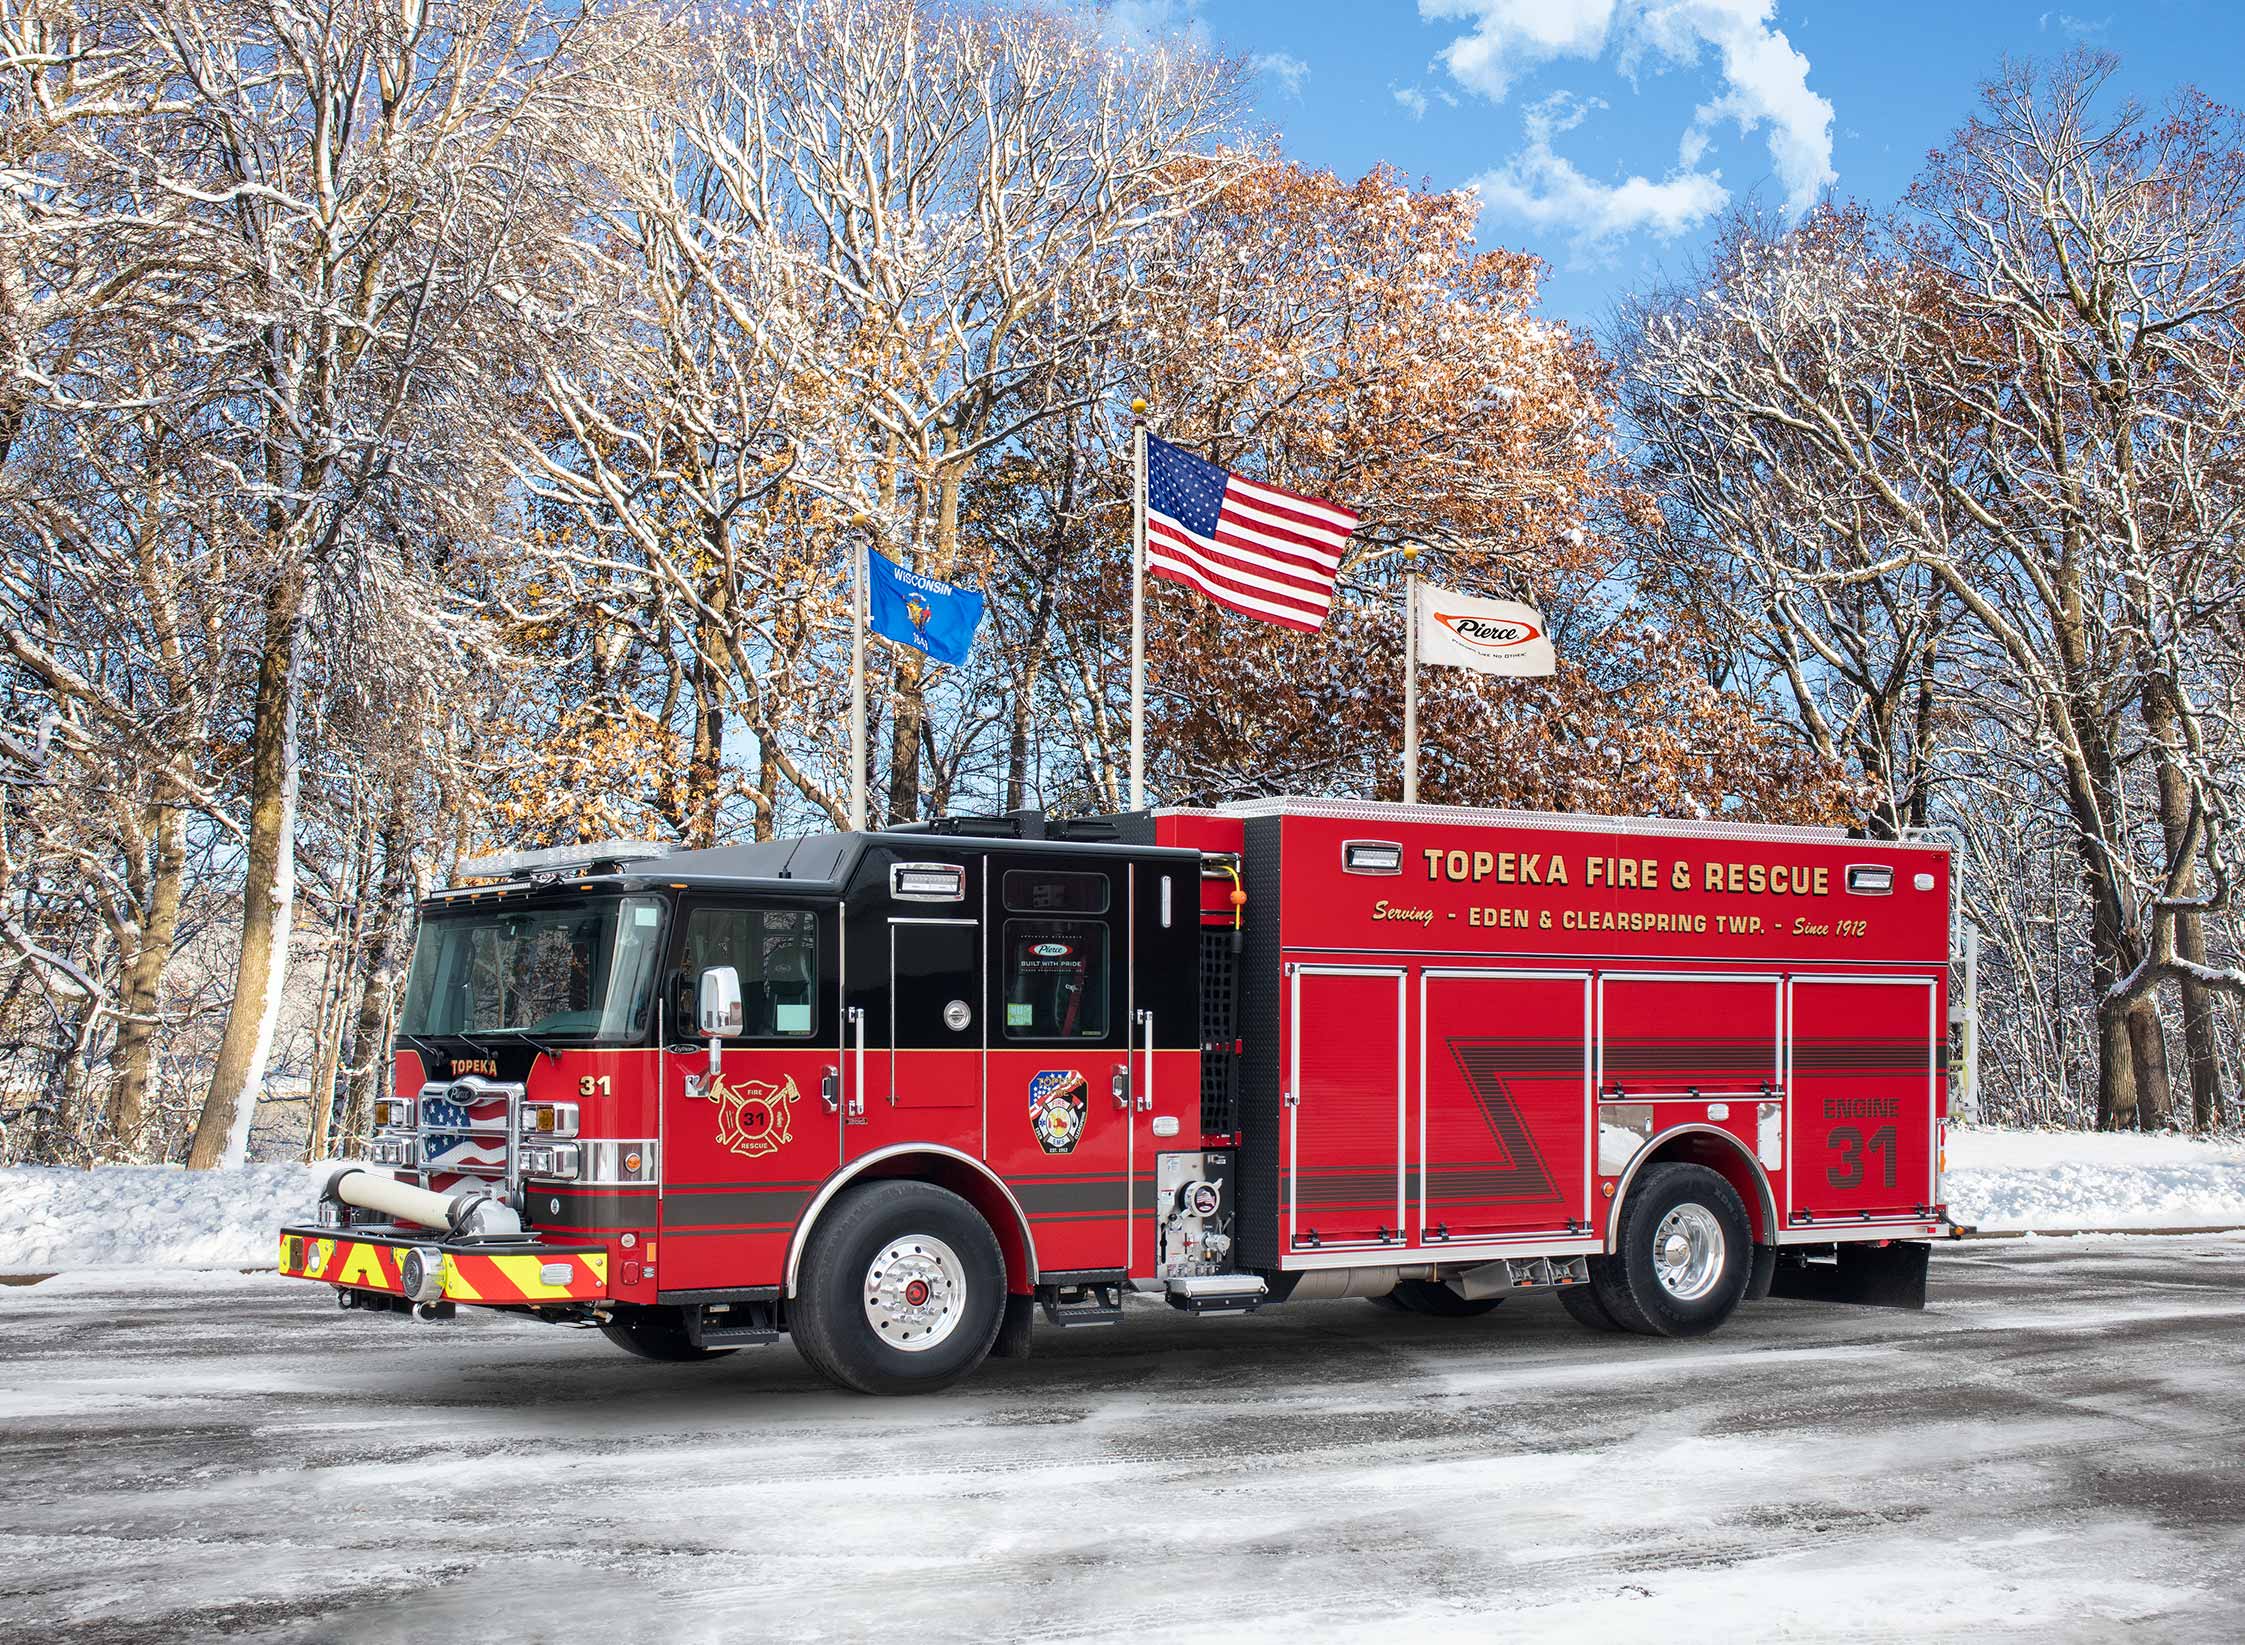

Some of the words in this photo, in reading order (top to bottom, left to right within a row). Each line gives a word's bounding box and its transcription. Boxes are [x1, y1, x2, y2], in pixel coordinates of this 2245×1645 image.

[894, 567, 952, 596] WISCONSIN
[1457, 619, 1517, 640] Pierce
[1424, 849, 1569, 885] TOPEKA
[1586, 856, 1658, 888] FIRE
[1671, 861, 1691, 890] &
[1704, 862, 1828, 896] RESCUE
[1372, 900, 1434, 928] Serving
[1469, 907, 1529, 929] EDEN
[1538, 911, 1553, 930] &
[1563, 911, 1706, 933] CLEARSPRING
[1716, 915, 1765, 935] TWP.
[1792, 917, 1829, 936] Since
[1835, 919, 1867, 937] 1912
[451, 1059, 497, 1077] TOPEKA
[579, 1075, 611, 1096] 31
[743, 1112, 765, 1126] 31
[1823, 1097, 1900, 1119] ENGINE
[1826, 1125, 1897, 1189] 31
